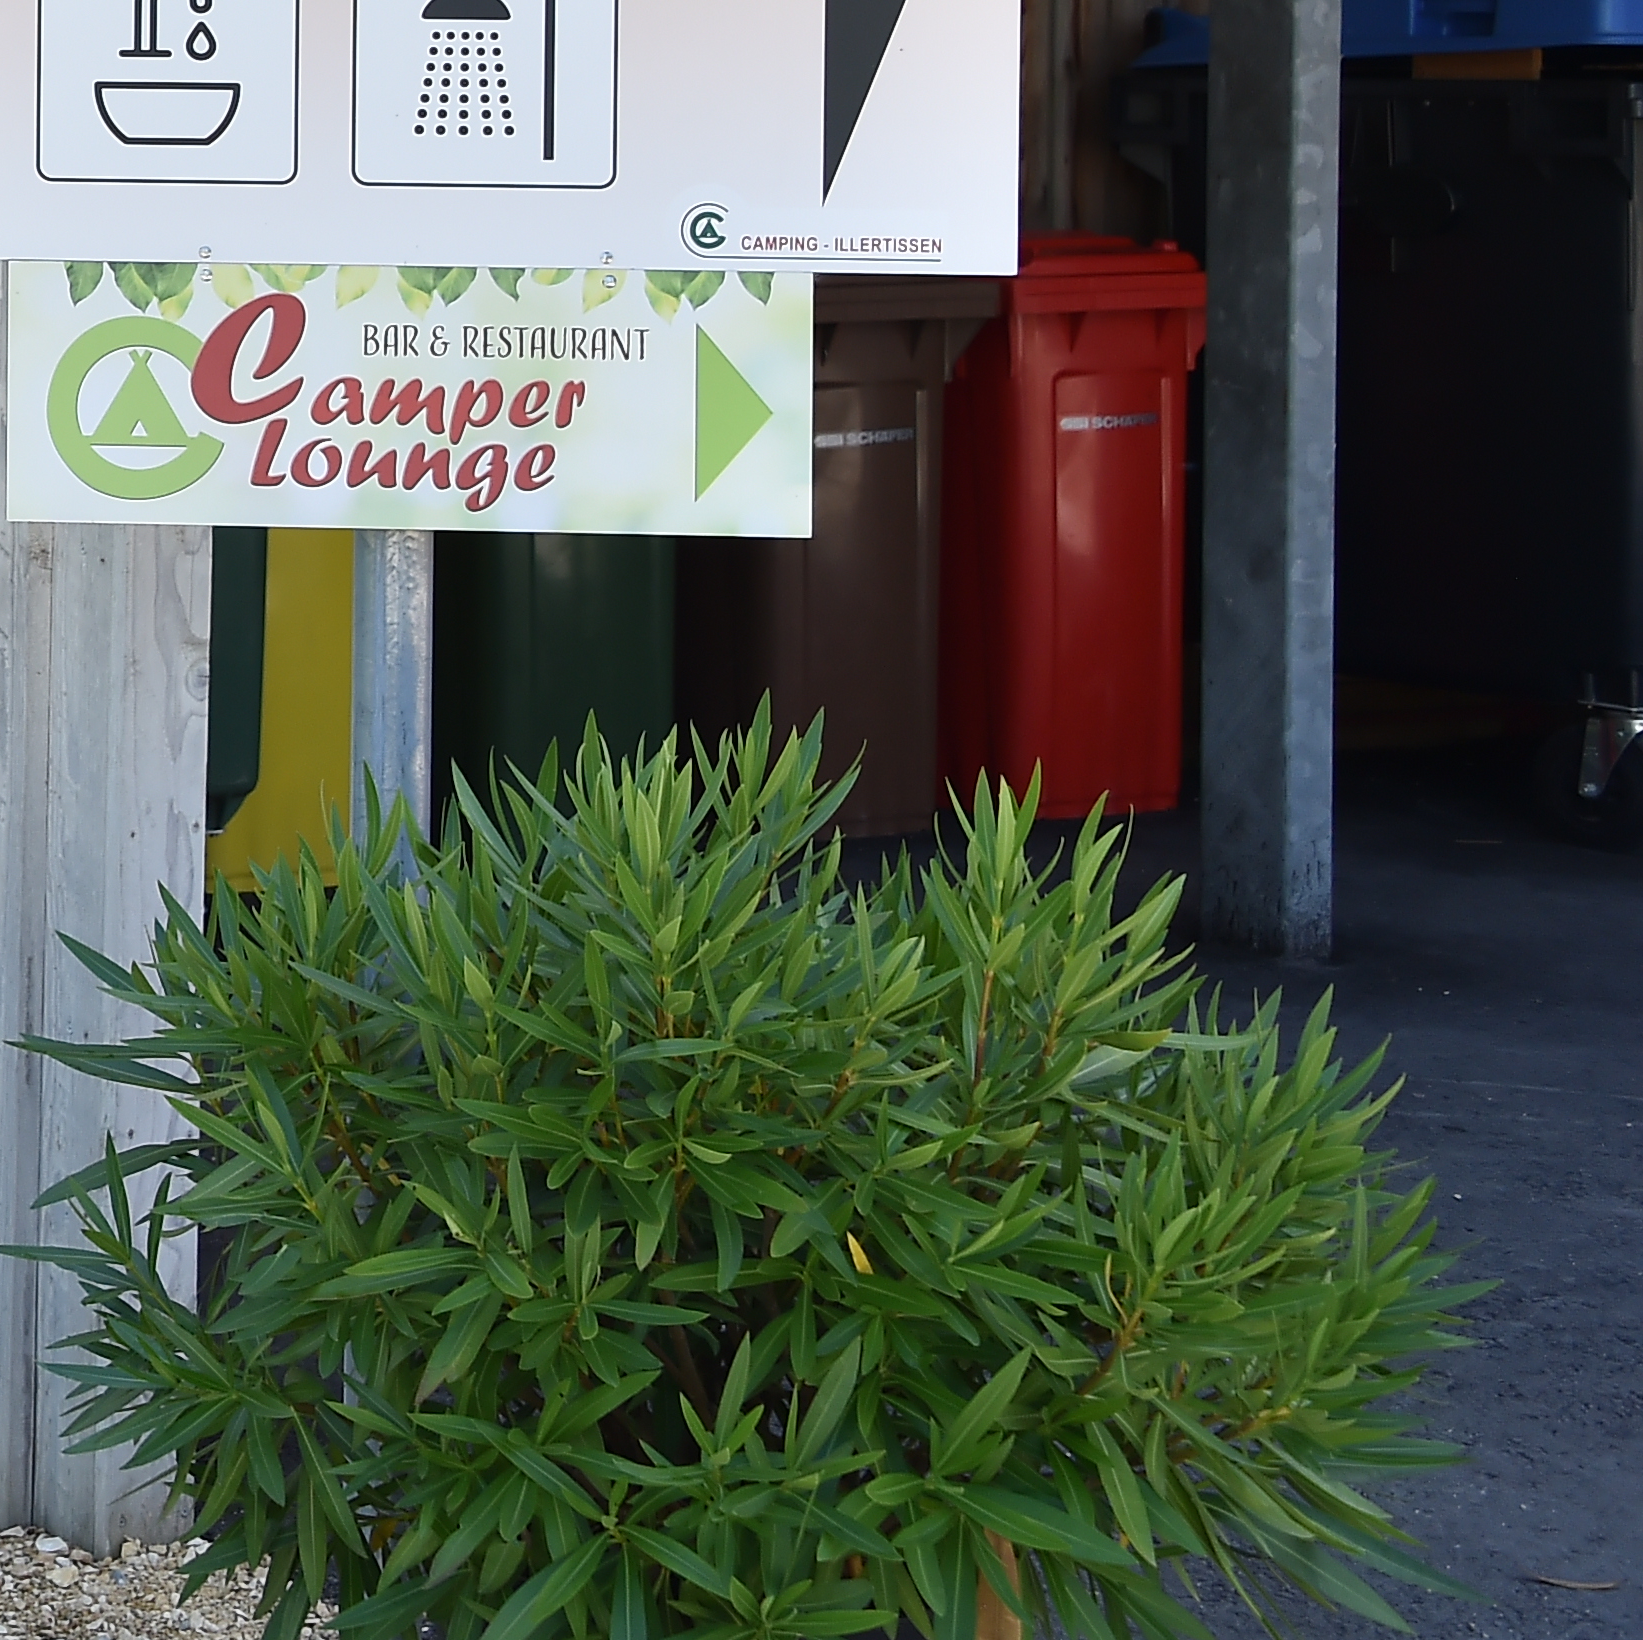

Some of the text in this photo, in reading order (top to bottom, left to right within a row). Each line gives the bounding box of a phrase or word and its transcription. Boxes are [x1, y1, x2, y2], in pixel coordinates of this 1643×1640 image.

[741, 235, 819, 252] CAMPING
[834, 237, 943, 253] ILLERTISSEN
[190, 292, 586, 445] Camper
[362, 323, 650, 361] BAR & RESTAURANT
[249, 417, 557, 513] Lounge
